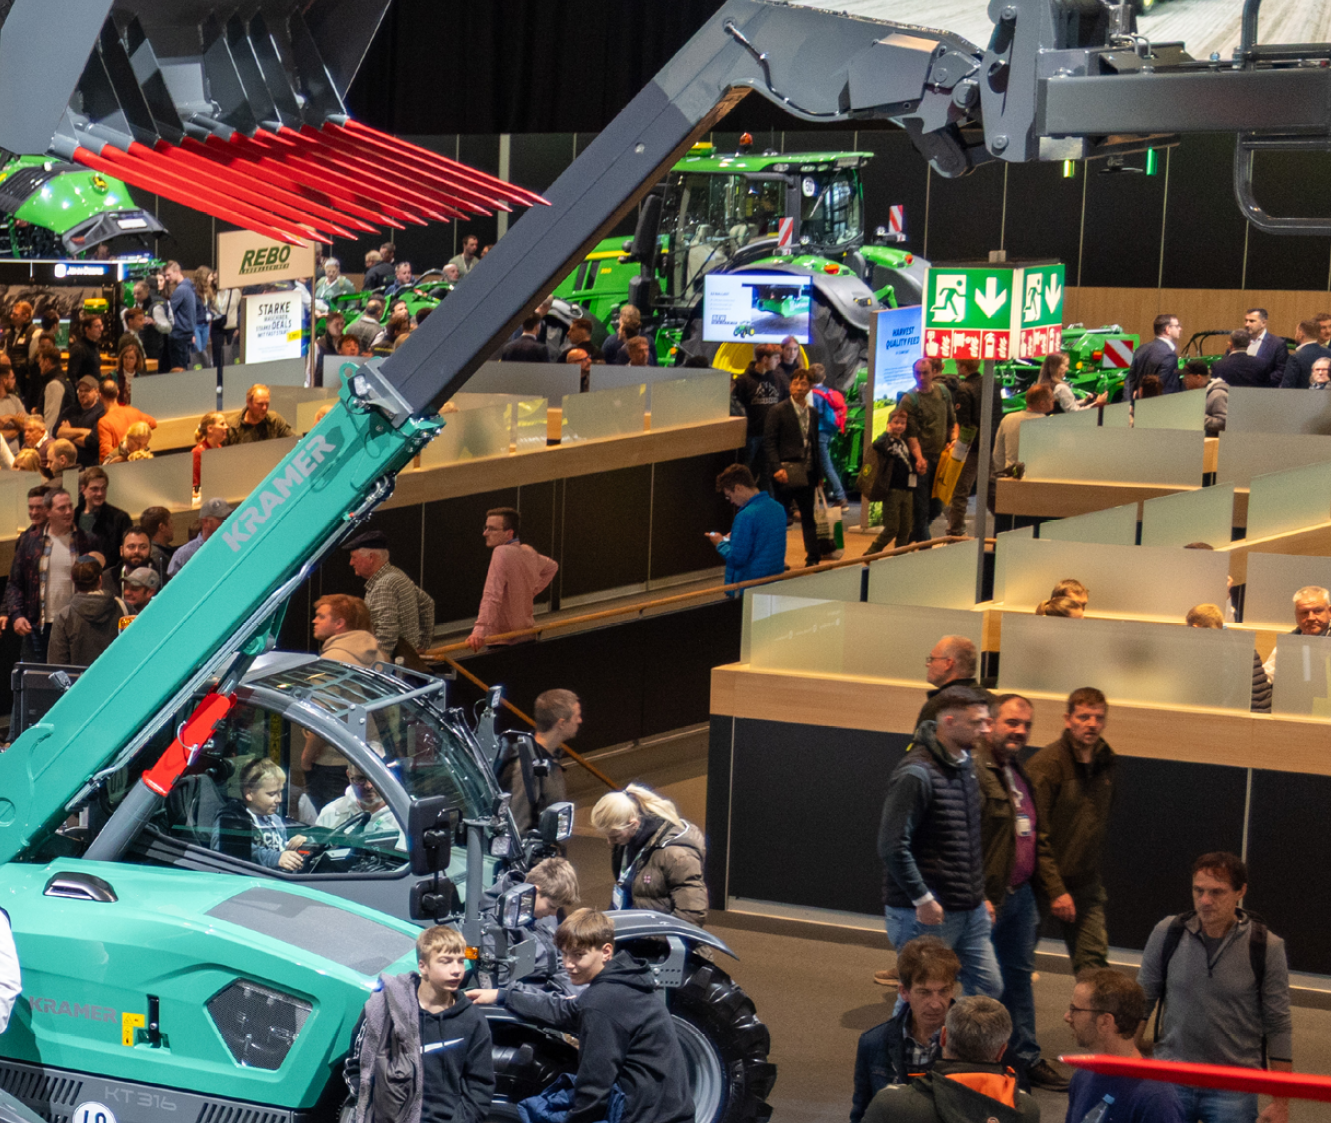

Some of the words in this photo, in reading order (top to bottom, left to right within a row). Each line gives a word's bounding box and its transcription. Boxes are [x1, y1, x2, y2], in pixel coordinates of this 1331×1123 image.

[239, 245, 291, 271] REBO
[258, 301, 291, 316] STARKE
[271, 319, 292, 330] DEALS
[892, 326, 915, 337] HARVEST
[221, 434, 336, 552] KRAMER
[28, 995, 118, 1025] KRAMER
